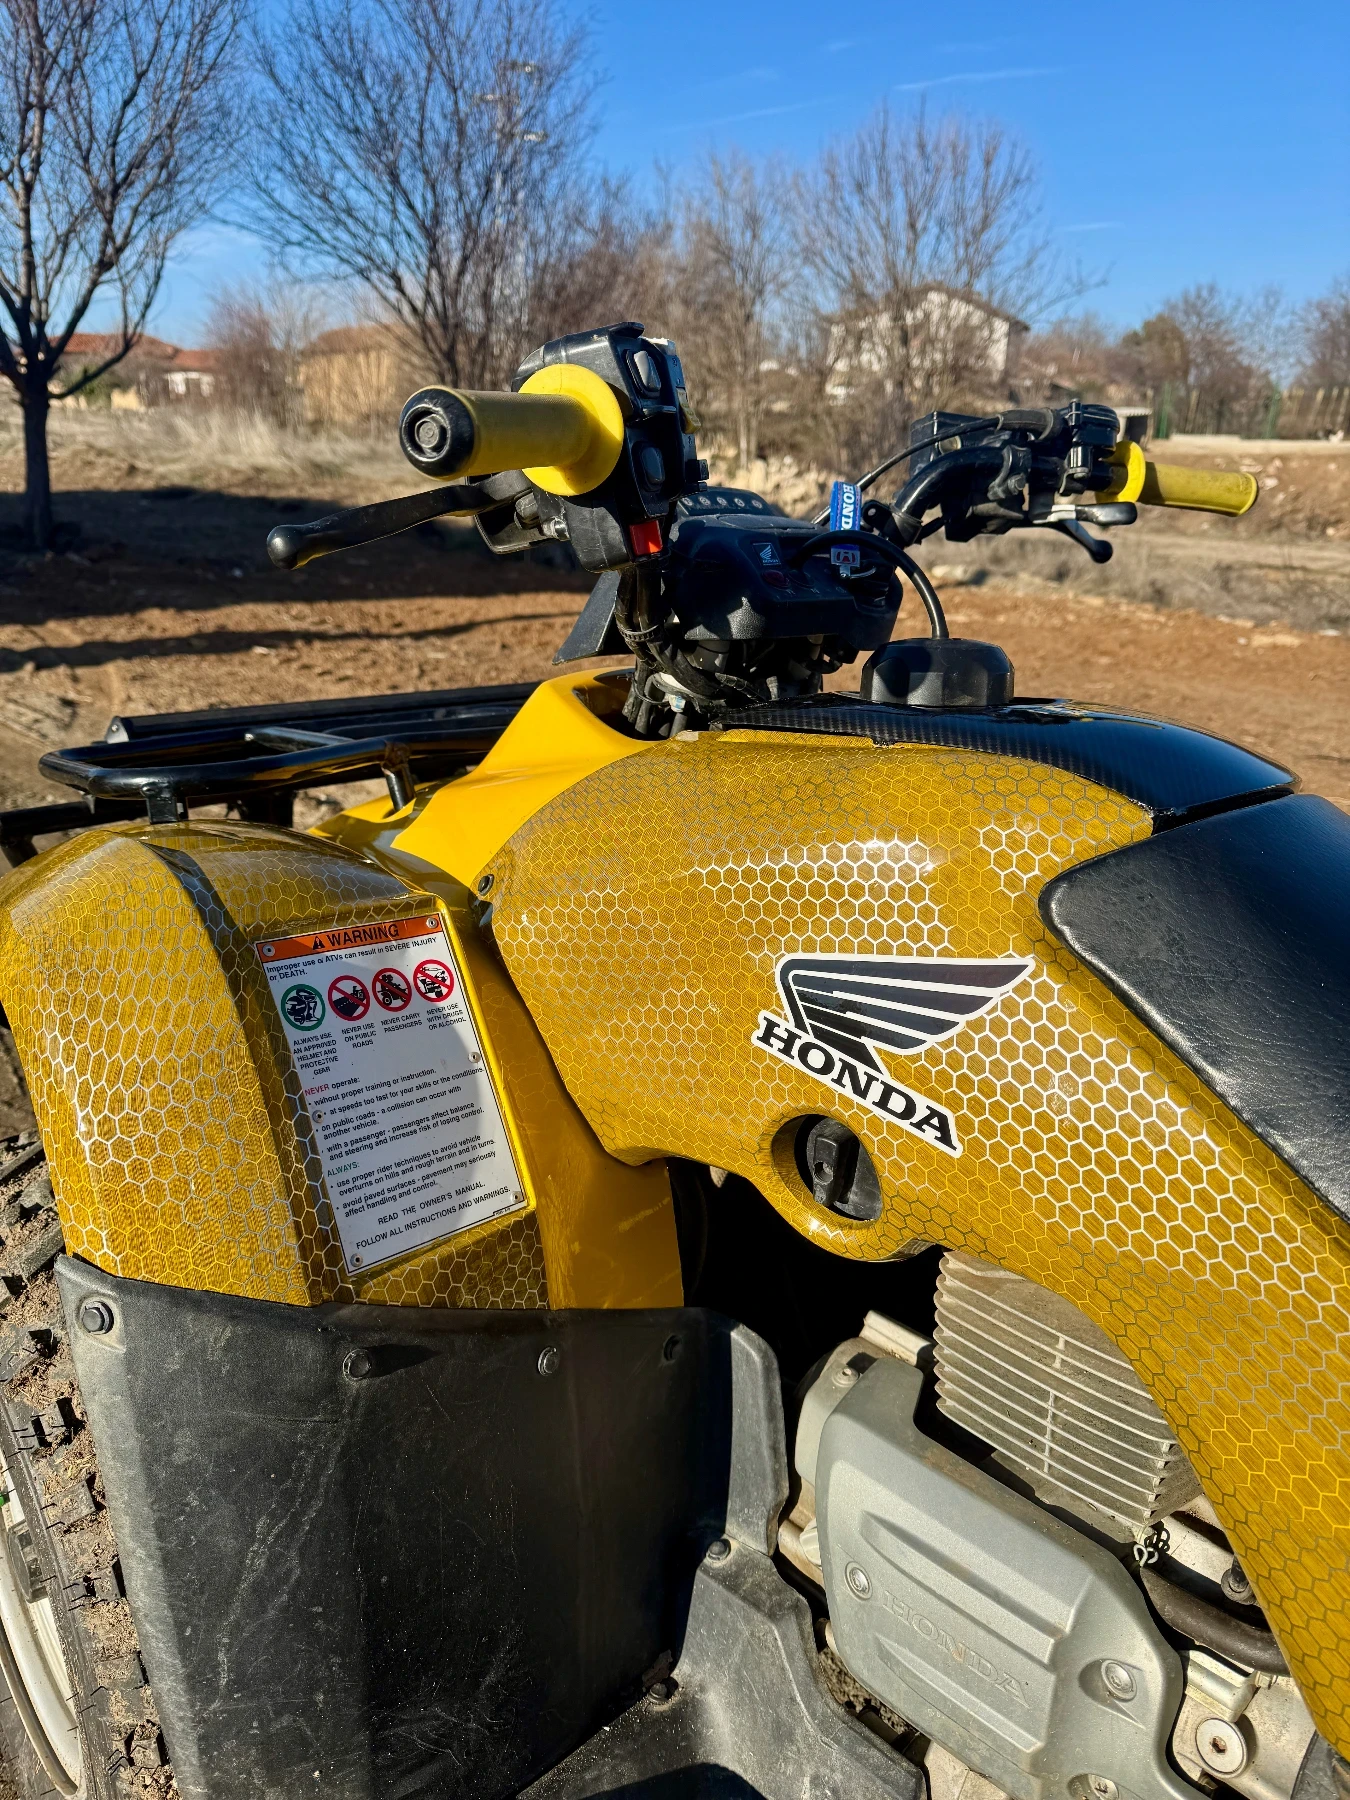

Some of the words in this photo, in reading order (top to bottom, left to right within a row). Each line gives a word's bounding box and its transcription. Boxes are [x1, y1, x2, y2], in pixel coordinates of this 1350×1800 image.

[841, 484, 855, 530] HOND
[327, 924, 400, 948] WARNING
[266, 962, 300, 973] Improper
[325, 954, 343, 962] ATVs
[357, 948, 376, 956] result
[384, 941, 410, 952] SEVERE
[411, 937, 436, 947] INJURY
[278, 969, 307, 979] DEATH.
[380, 1016, 400, 1025] NEVER
[401, 1013, 420, 1021] CARRY
[426, 1006, 446, 1015] NEVER
[446, 1002, 458, 1010] USE
[341, 1025, 361, 1034] NEVER
[384, 1019, 422, 1033] PASSENGERS
[439, 1016, 466, 1027] ALCOHOL
[293, 1035, 319, 1046] ALWAYS
[304, 1039, 336, 1052] APPROVED
[352, 1039, 373, 1048] ROADS
[354, 1030, 376, 1040] PUBLIC
[297, 1051, 322, 1062] HELMET
[323, 1047, 336, 1055] AND
[300, 1055, 338, 1069] PROTECTIVE
[313, 1066, 330, 1075] GEAR
[304, 1083, 329, 1096] NEVER
[331, 1077, 360, 1089] operate:
[314, 1094, 339, 1105] without
[341, 1088, 363, 1100] proper
[365, 1080, 391, 1091] training
[400, 1068, 436, 1082] instruction.
[756, 1016, 957, 1152] HONDA
[338, 1101, 362, 1113] speeds
[375, 1093, 388, 1101] fast
[399, 1086, 413, 1096] your
[415, 1081, 431, 1090] skills
[332, 1117, 354, 1130] public
[355, 1111, 375, 1121] roads
[386, 1100, 414, 1112] collision
[428, 1090, 446, 1099] occur
[324, 1127, 350, 1140] another
[326, 1142, 342, 1152] with
[350, 1130, 385, 1147] passenger
[391, 1116, 430, 1133] passengers
[431, 1109, 449, 1120] affect
[449, 1102, 474, 1114] balance
[329, 1151, 343, 1160] and
[344, 1142, 373, 1156] steering
[374, 1136, 388, 1146] and
[388, 1128, 417, 1141] increase
[418, 1124, 431, 1132] risk
[439, 1115, 460, 1125] losing
[327, 1161, 359, 1177] ALWAYS:
[336, 1179, 350, 1187] use
[351, 1170, 374, 1184] proper
[376, 1164, 392, 1174] rider
[394, 1152, 431, 1168] techniques
[440, 1141, 457, 1152] avoid
[458, 1135, 480, 1146] vehicle
[339, 1180, 373, 1195] overturns
[384, 1171, 399, 1180] hills
[401, 1165, 414, 1175] and
[415, 1158, 434, 1169] rough
[435, 1151, 457, 1162] terrain
[458, 1146, 470, 1155] and
[343, 1196, 363, 1211] avoid
[363, 1188, 385, 1203] paved
[386, 1179, 416, 1193] surfaces
[421, 1165, 453, 1182] pavement
[454, 1161, 467, 1169] may
[468, 1151, 495, 1164] seriously
[344, 1205, 365, 1217] affect
[366, 1194, 397, 1209] handling
[398, 1188, 411, 1198] and
[378, 1212, 398, 1224] READ
[401, 1205, 416, 1215] THE
[419, 1192, 452, 1209] OWNER'S
[455, 1181, 485, 1195] MANUAL.
[356, 1232, 387, 1249] FOLLOW
[390, 1227, 403, 1236] ALL
[404, 1205, 456, 1231] INSTRUCTIONS
[458, 1200, 472, 1210] AND
[473, 1186, 510, 1204] WARNINGS.
[882, 1590, 1030, 1709] HONDA
